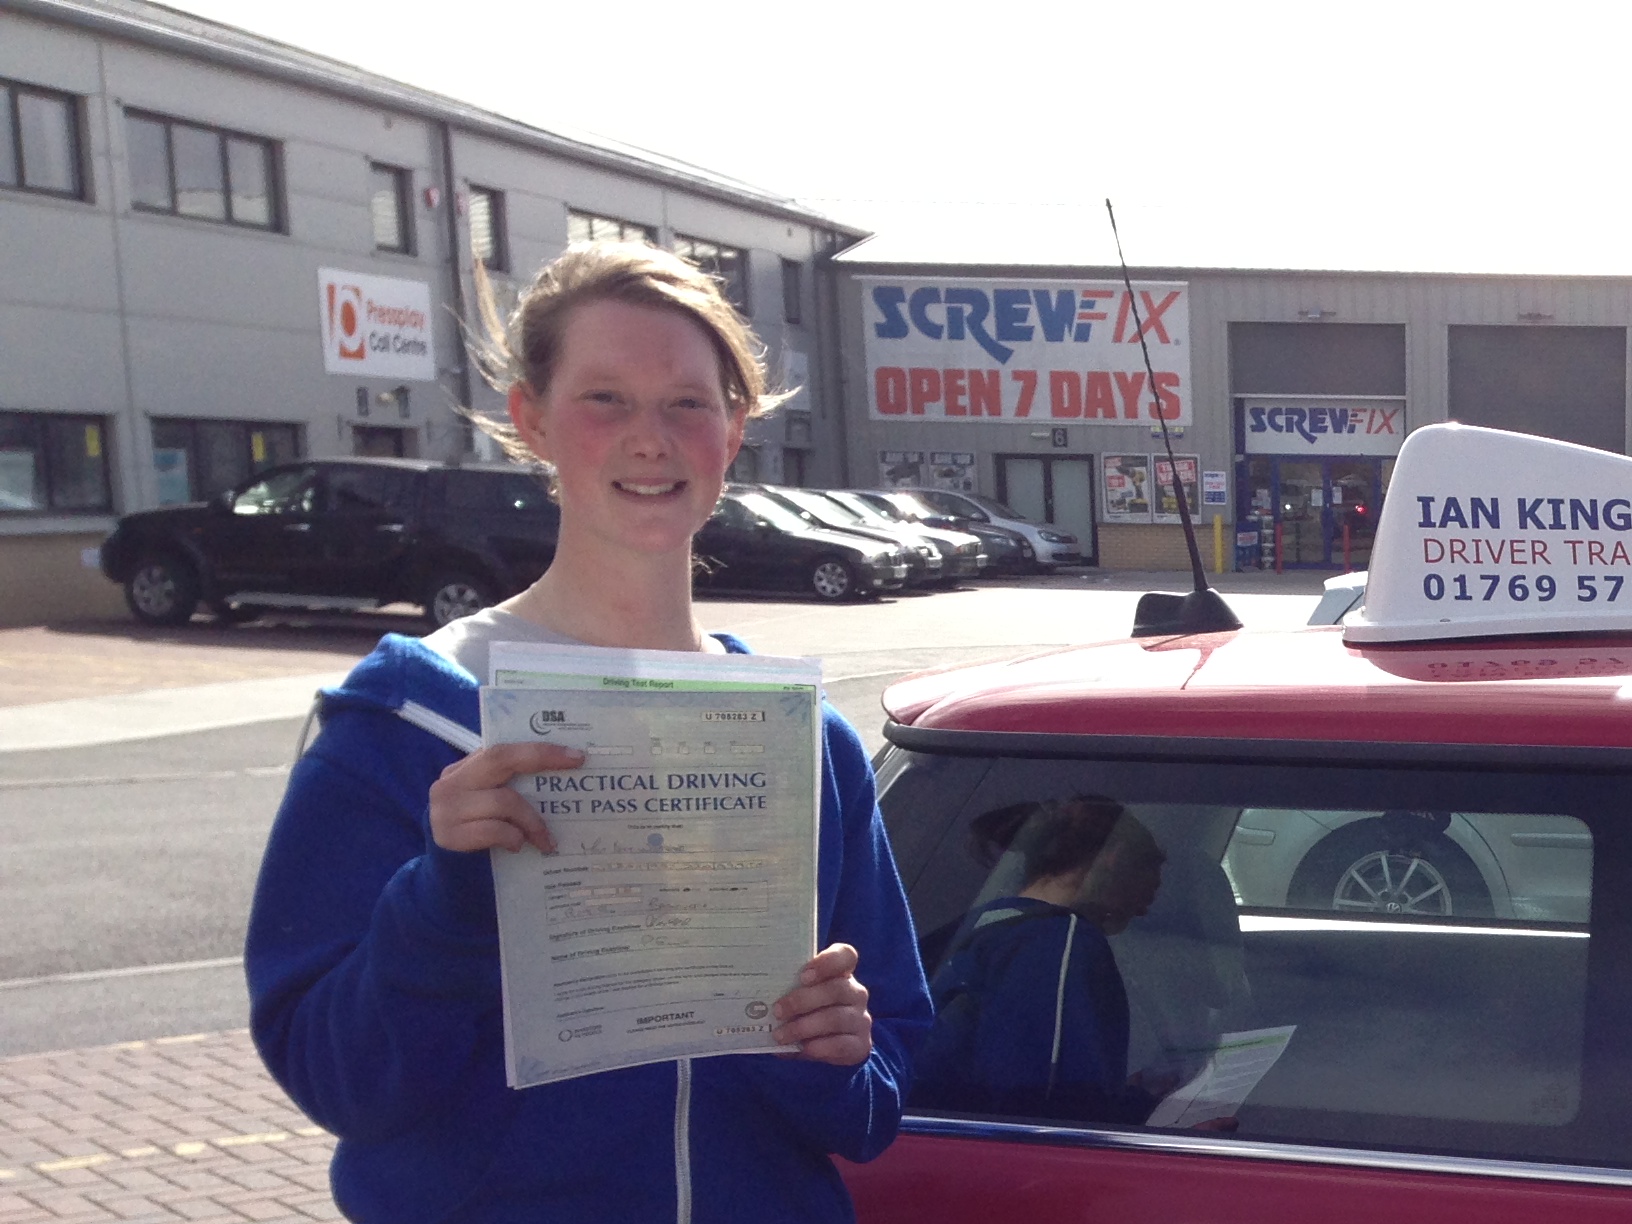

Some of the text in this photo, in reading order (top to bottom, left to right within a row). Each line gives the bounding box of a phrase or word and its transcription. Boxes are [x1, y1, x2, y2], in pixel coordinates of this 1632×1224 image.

[872, 286, 1182, 365] SCREWFIX
[874, 366, 1182, 420] OPEN 7 DAYS
[1054, 429, 1068, 446] 6
[1249, 407, 1401, 445] SCREWFIX
[1416, 495, 1501, 530] IAN
[1422, 537, 1552, 566] DRIVER
[1422, 573, 1557, 601] 01769
[603, 677, 674, 690] Driving Test Report
[542, 710, 566, 722] DSA
[535, 771, 767, 793] PRACTICAL DRIVING
[538, 795, 768, 815] TEST PASS CERTIFICATE
[637, 1011, 695, 1025] IMPORTANT
